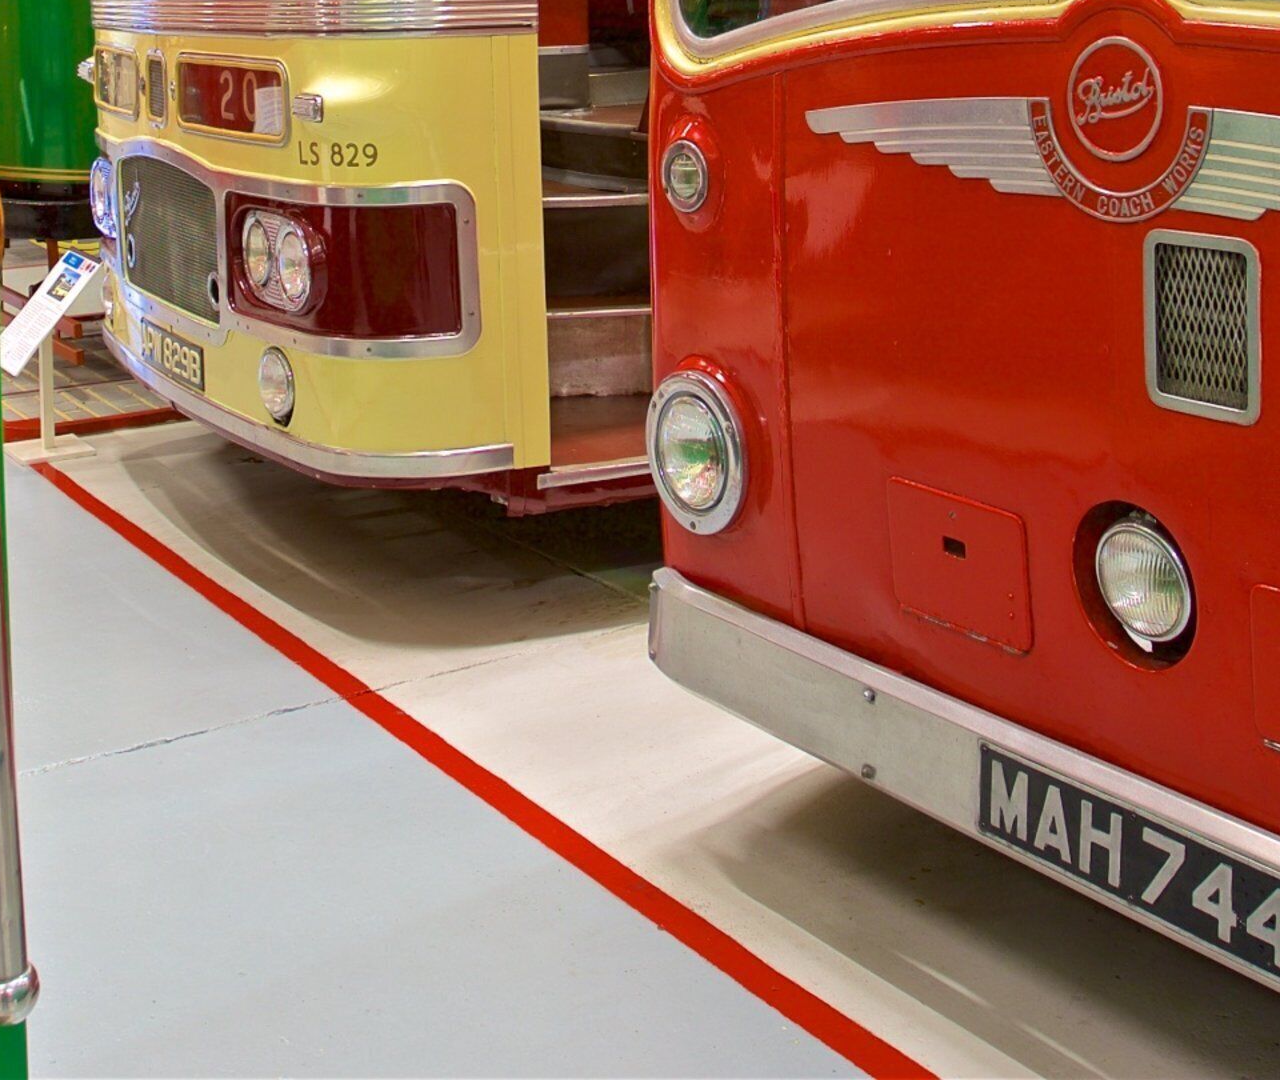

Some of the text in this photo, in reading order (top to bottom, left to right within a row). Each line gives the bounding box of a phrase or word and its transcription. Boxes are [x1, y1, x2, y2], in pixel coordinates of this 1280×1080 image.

[1077, 68, 1156, 126] Bristol
[298, 140, 378, 168] LS 829
[1031, 114, 1205, 218] EASTERN COACH WORKS
[163, 336, 201, 385] 829B
[989, 759, 1123, 888] MAH
